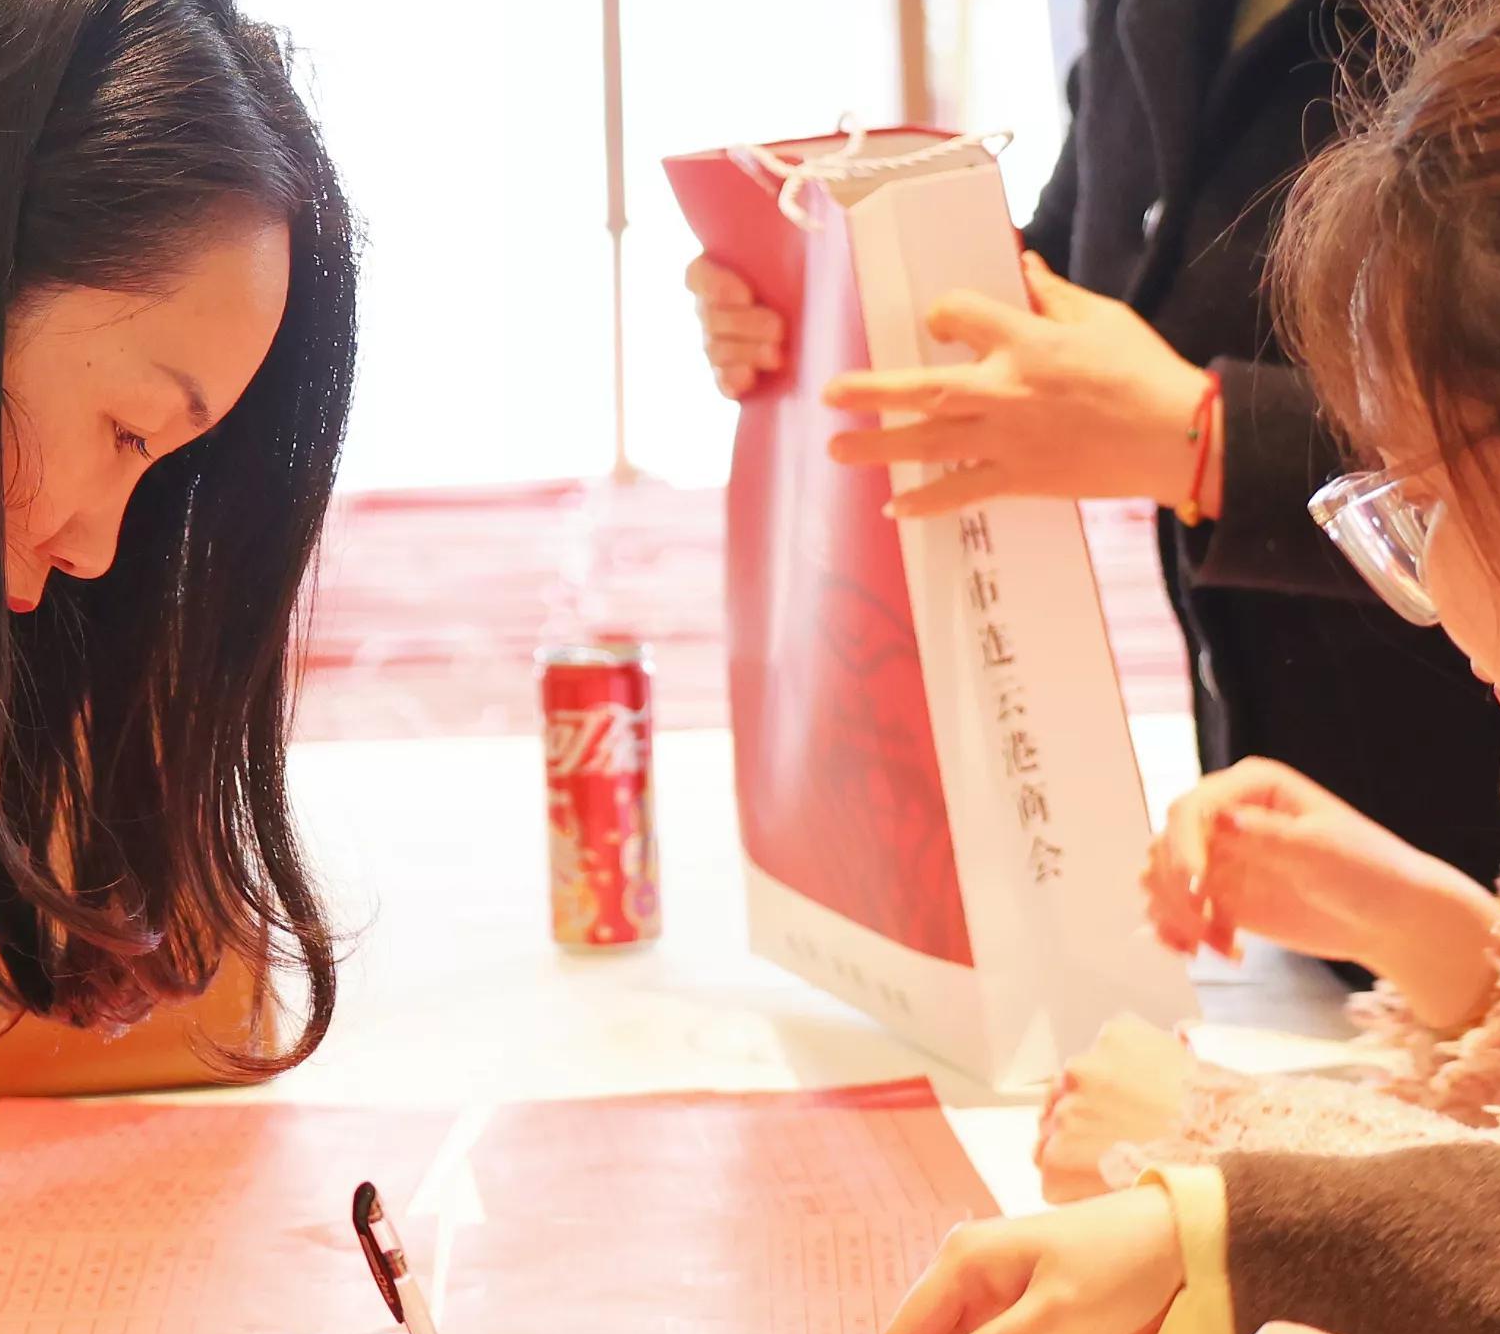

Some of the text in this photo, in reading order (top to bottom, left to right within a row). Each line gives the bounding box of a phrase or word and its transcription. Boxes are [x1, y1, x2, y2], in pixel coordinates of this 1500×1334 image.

[944, 457, 1067, 884] 州市连云港商会
